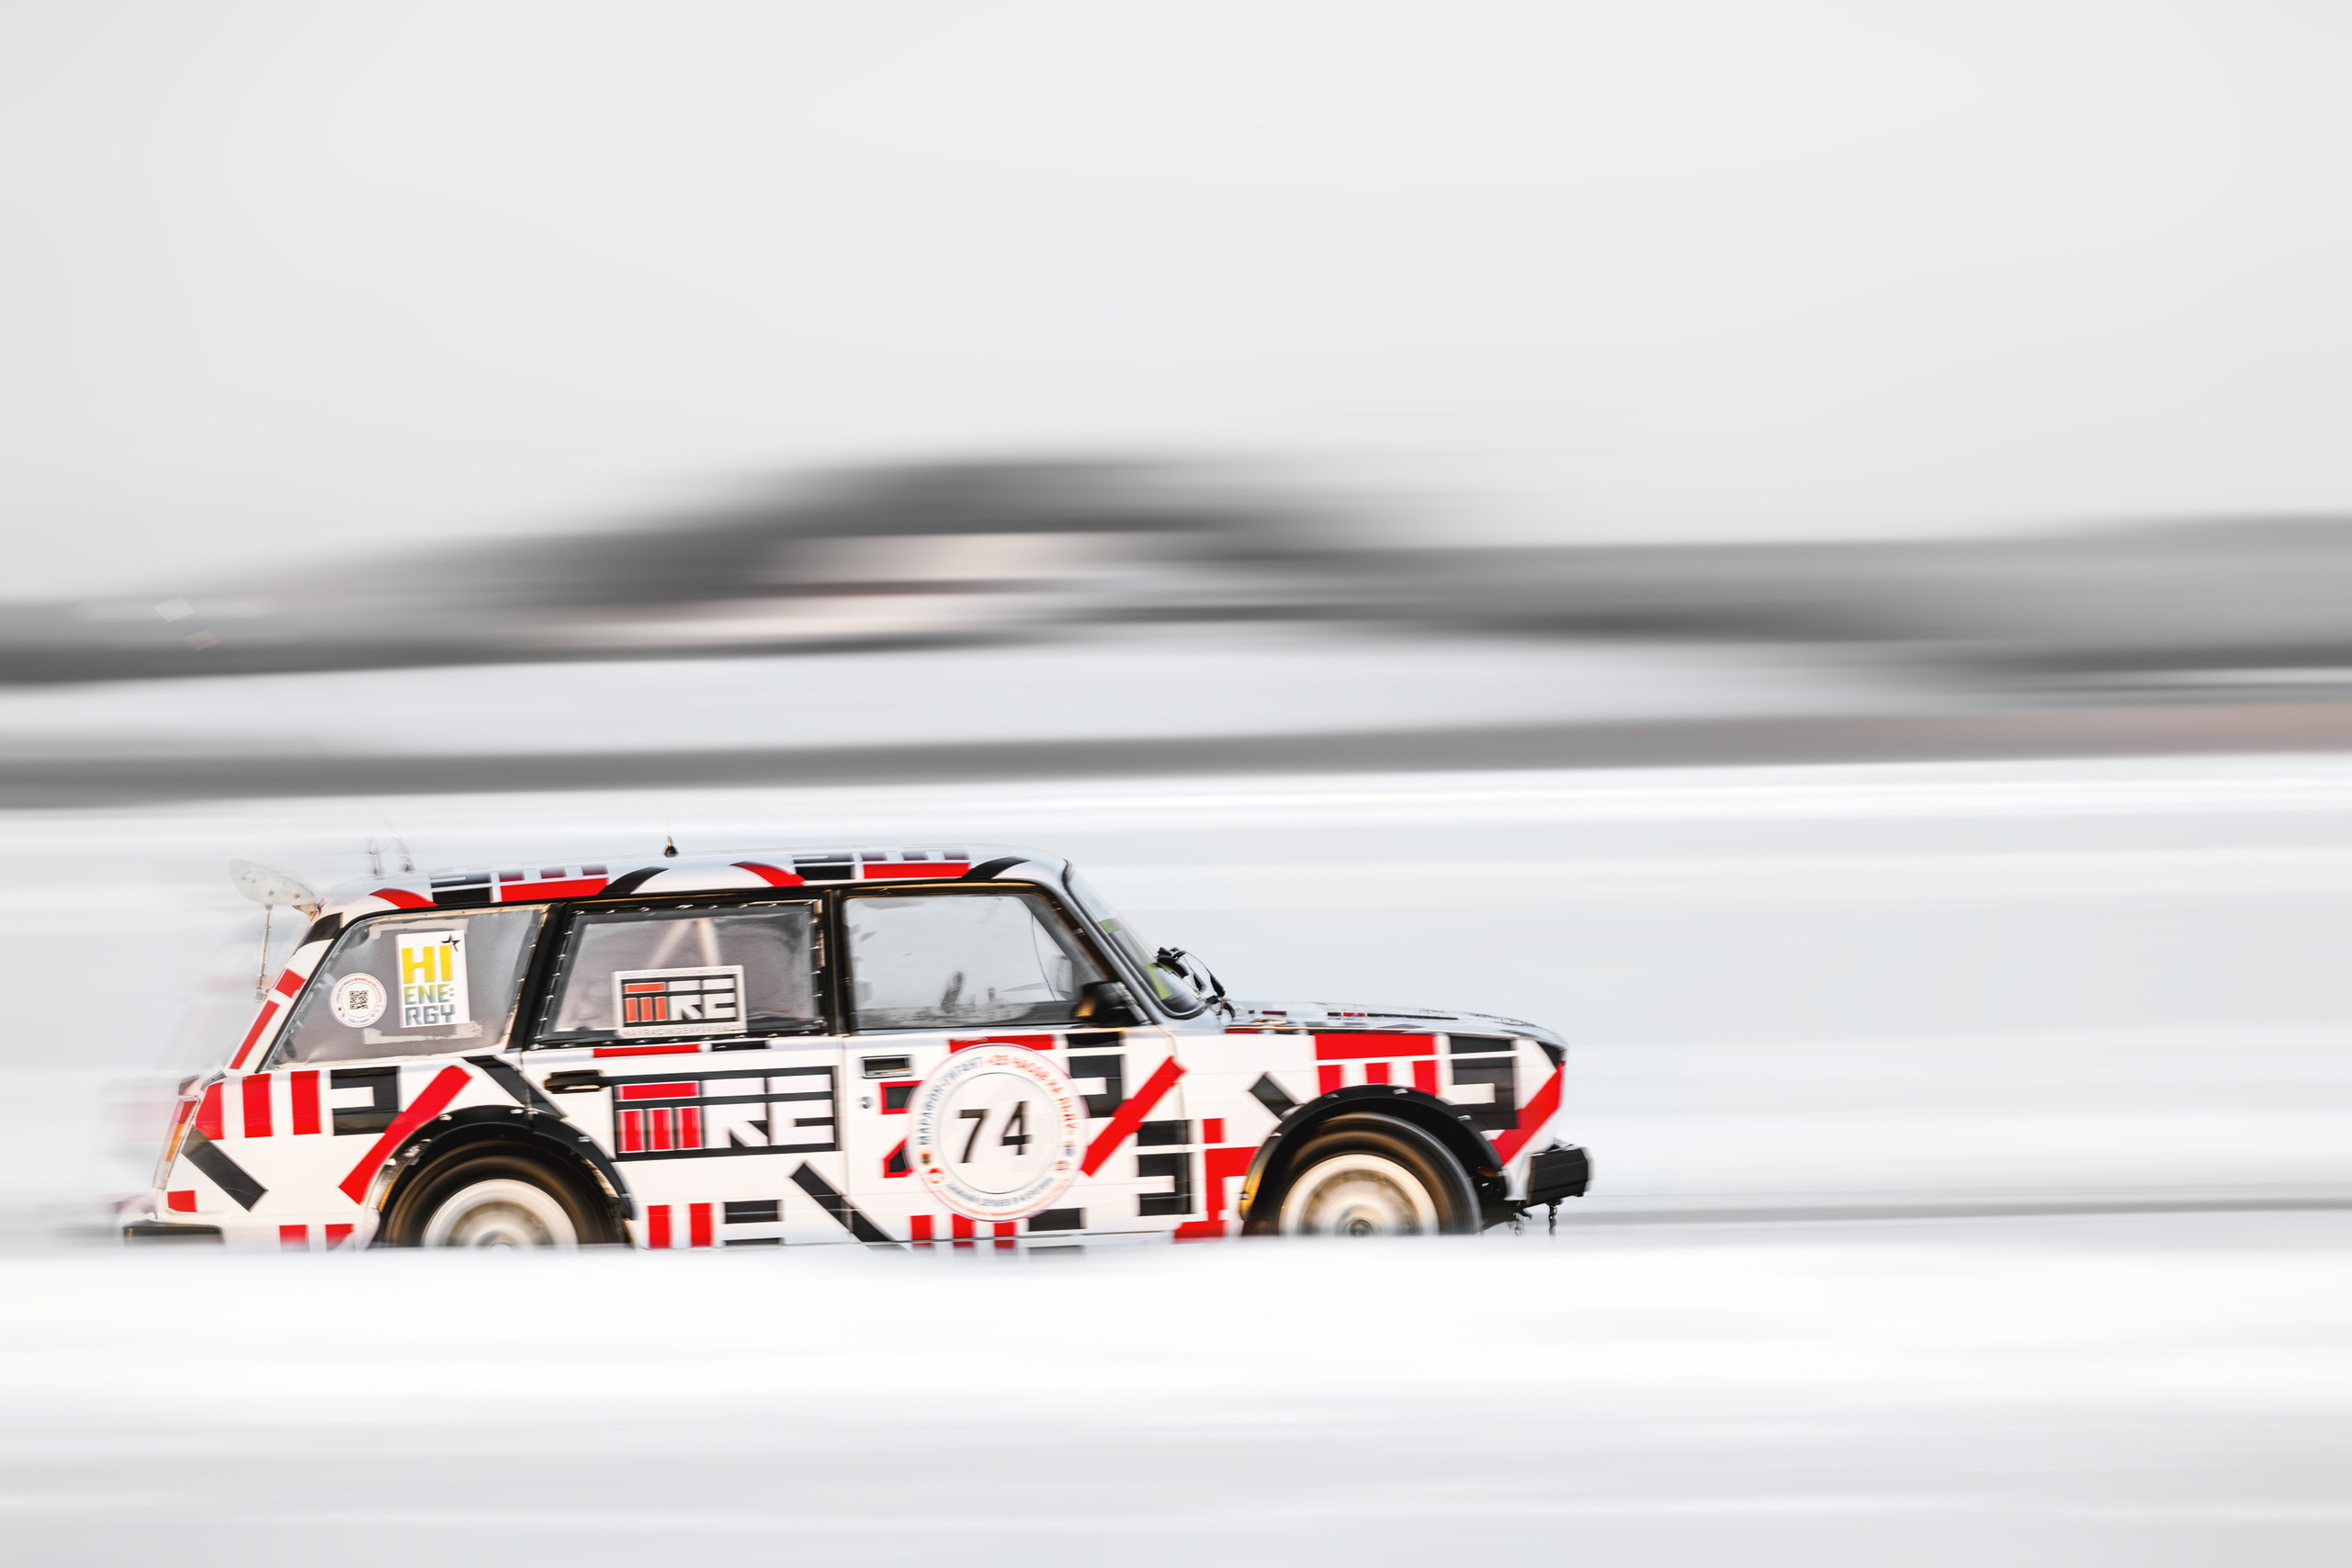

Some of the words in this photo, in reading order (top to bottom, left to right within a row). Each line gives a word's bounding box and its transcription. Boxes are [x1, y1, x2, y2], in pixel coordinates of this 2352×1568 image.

[401, 944, 454, 984] HI
[405, 1004, 456, 1026] RGY
[956, 1100, 1035, 1164] 74
